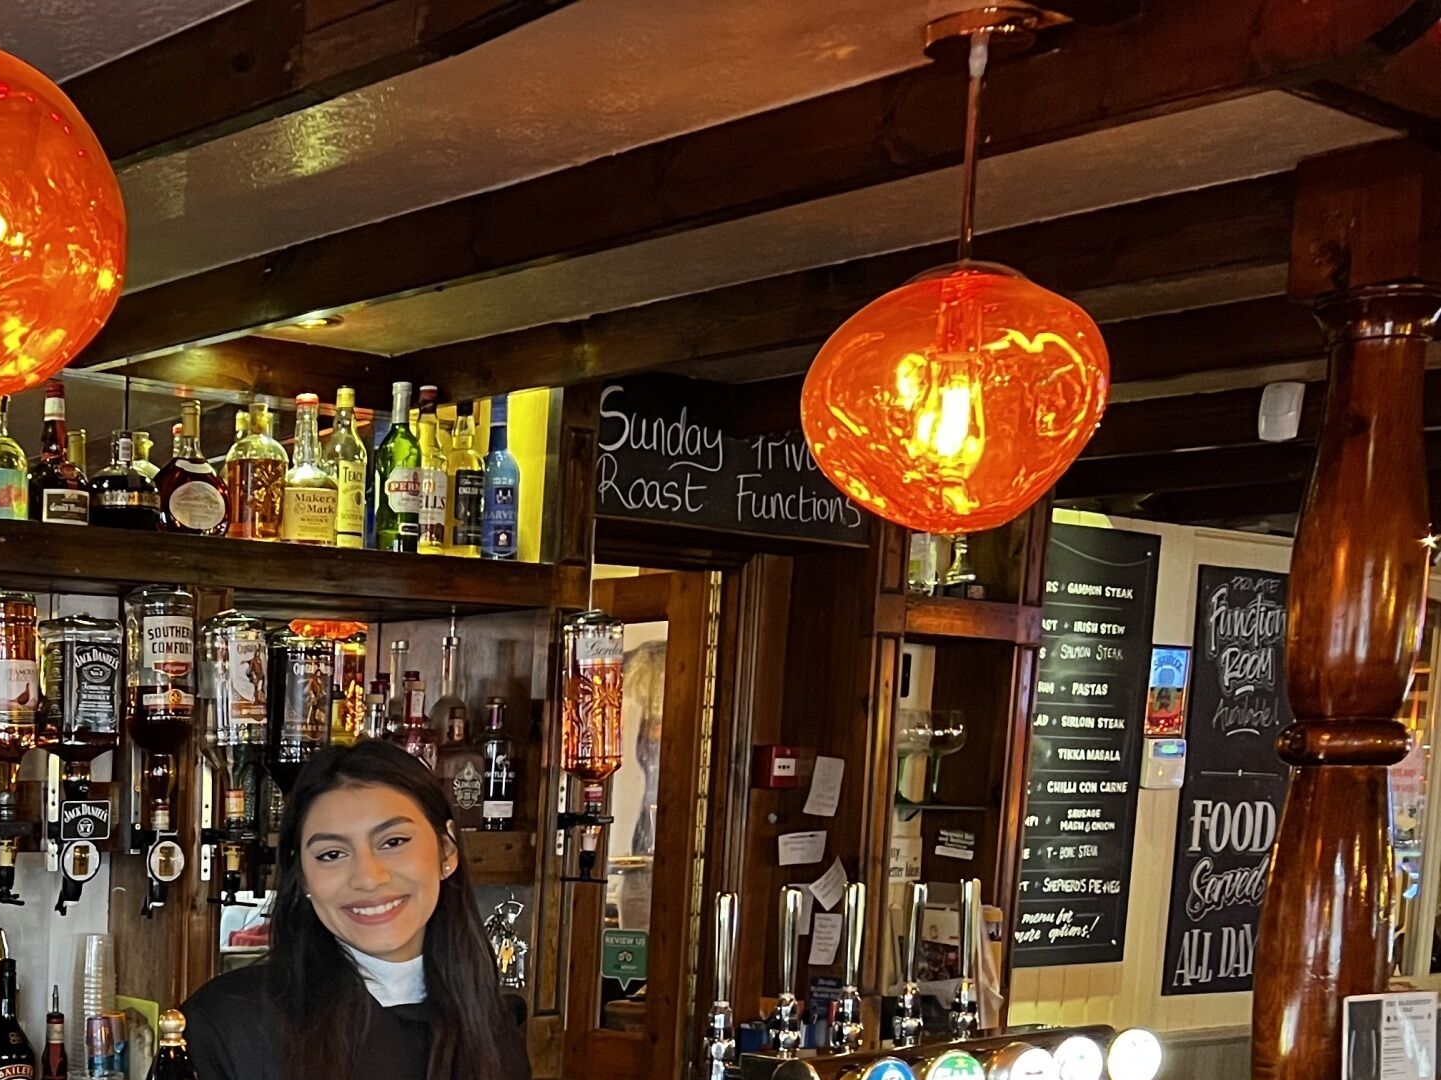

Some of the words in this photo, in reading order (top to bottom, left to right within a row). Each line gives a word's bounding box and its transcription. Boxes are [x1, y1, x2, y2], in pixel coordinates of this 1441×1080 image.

[598, 385, 723, 471] Sunday
[597, 453, 707, 512] Roast
[306, 504, 335, 514] Mark
[736, 473, 861, 528] Functions
[1105, 586, 1134, 600] STEAK
[1074, 621, 1098, 634] IRISH
[1100, 621, 1125, 635] STEW
[75, 651, 93, 668] JACK
[1060, 643, 1091, 660] SALMON
[1096, 644, 1124, 660] STEAK
[1072, 682, 1108, 696] PASTAS
[1061, 715, 1095, 728] SIRLOIN
[1097, 717, 1125, 729] STEAK
[1058, 748, 1085, 760] TIKKA
[1087, 748, 1121, 761] MASALA
[1047, 781, 1077, 793] CHILLI
[1079, 781, 1097, 793] CON
[1100, 781, 1128, 793] CARNE
[64, 807, 83, 823] JACK
[81, 804, 109, 823] DANIEL'S
[1067, 808, 1101, 819] SAUSAGE
[1060, 820, 1085, 831] MASH
[1092, 821, 1115, 831] ONION
[1188, 799, 1276, 853] FOOD
[1187, 856, 1270, 921] Served
[1021, 912, 1055, 925] menu
[1055, 908, 1074, 926] for
[1172, 928, 1213, 987] ALL
[1217, 923, 1254, 979] DAY
